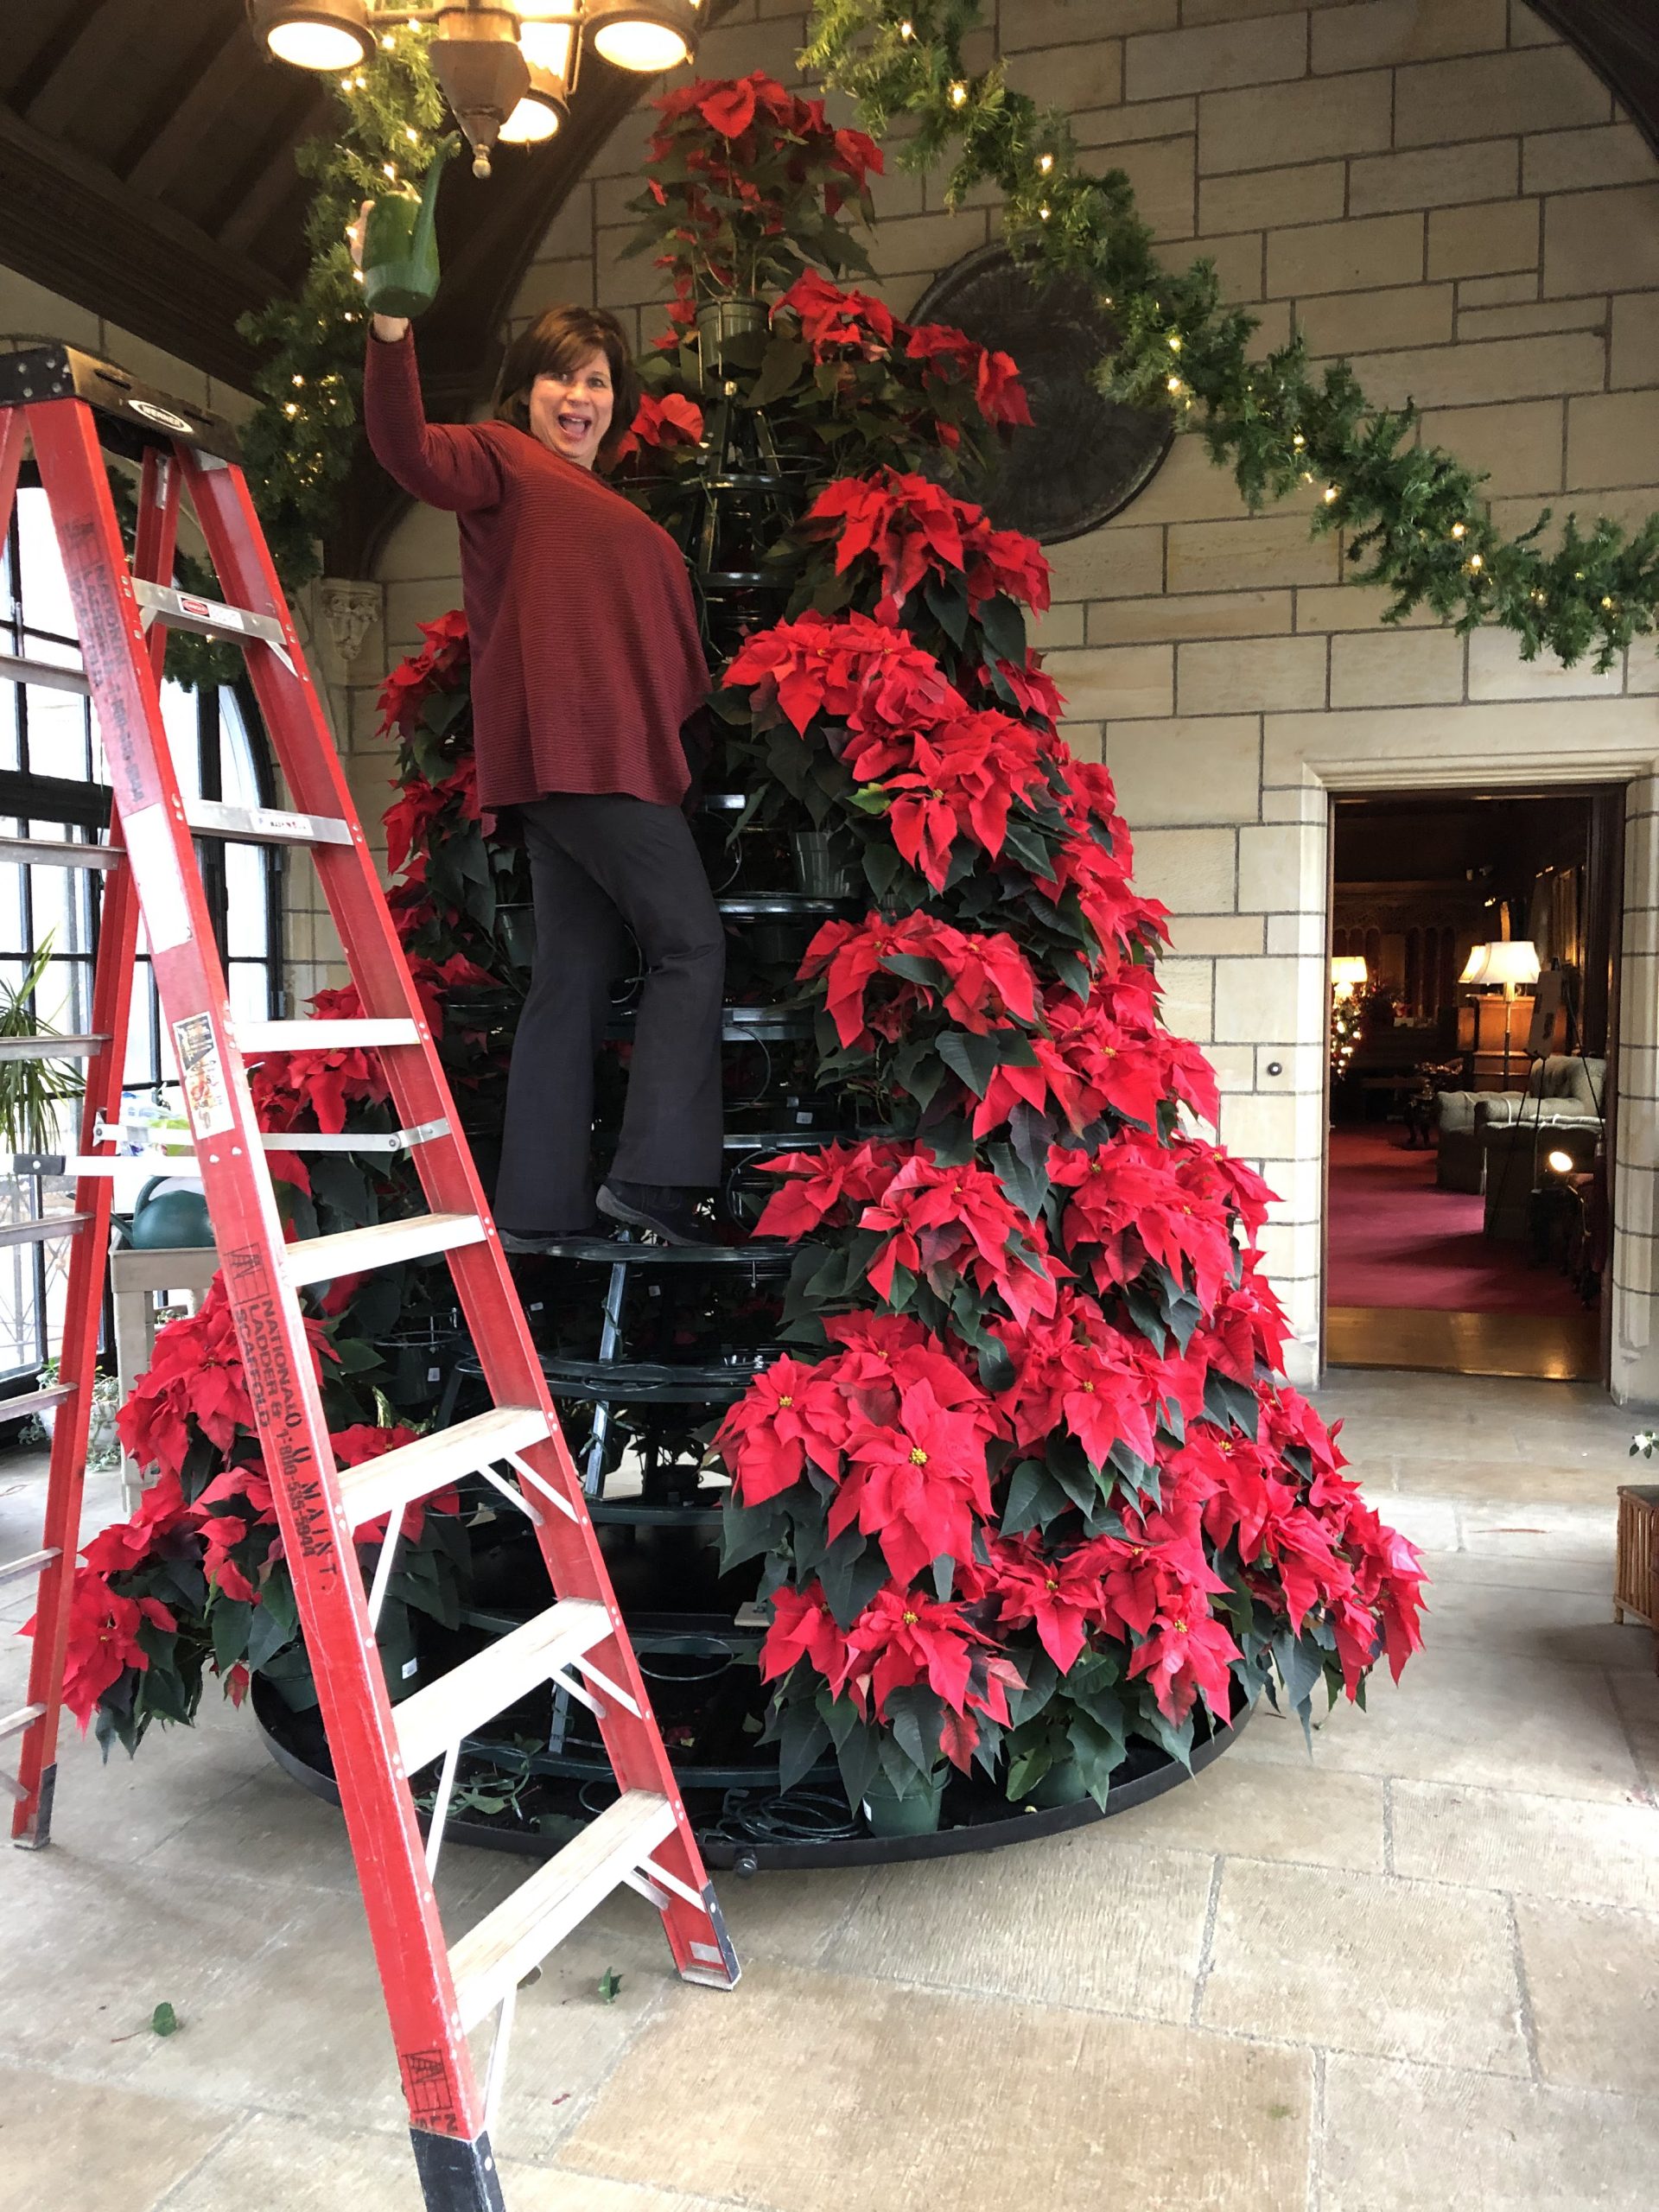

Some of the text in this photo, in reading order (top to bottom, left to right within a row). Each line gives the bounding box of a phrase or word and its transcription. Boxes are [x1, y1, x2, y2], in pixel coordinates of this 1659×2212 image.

[236, 1308, 270, 1427] SCAFFOLD
[250, 1304, 277, 1396] LADDER
[262, 1299, 296, 1414] NATIONAL
